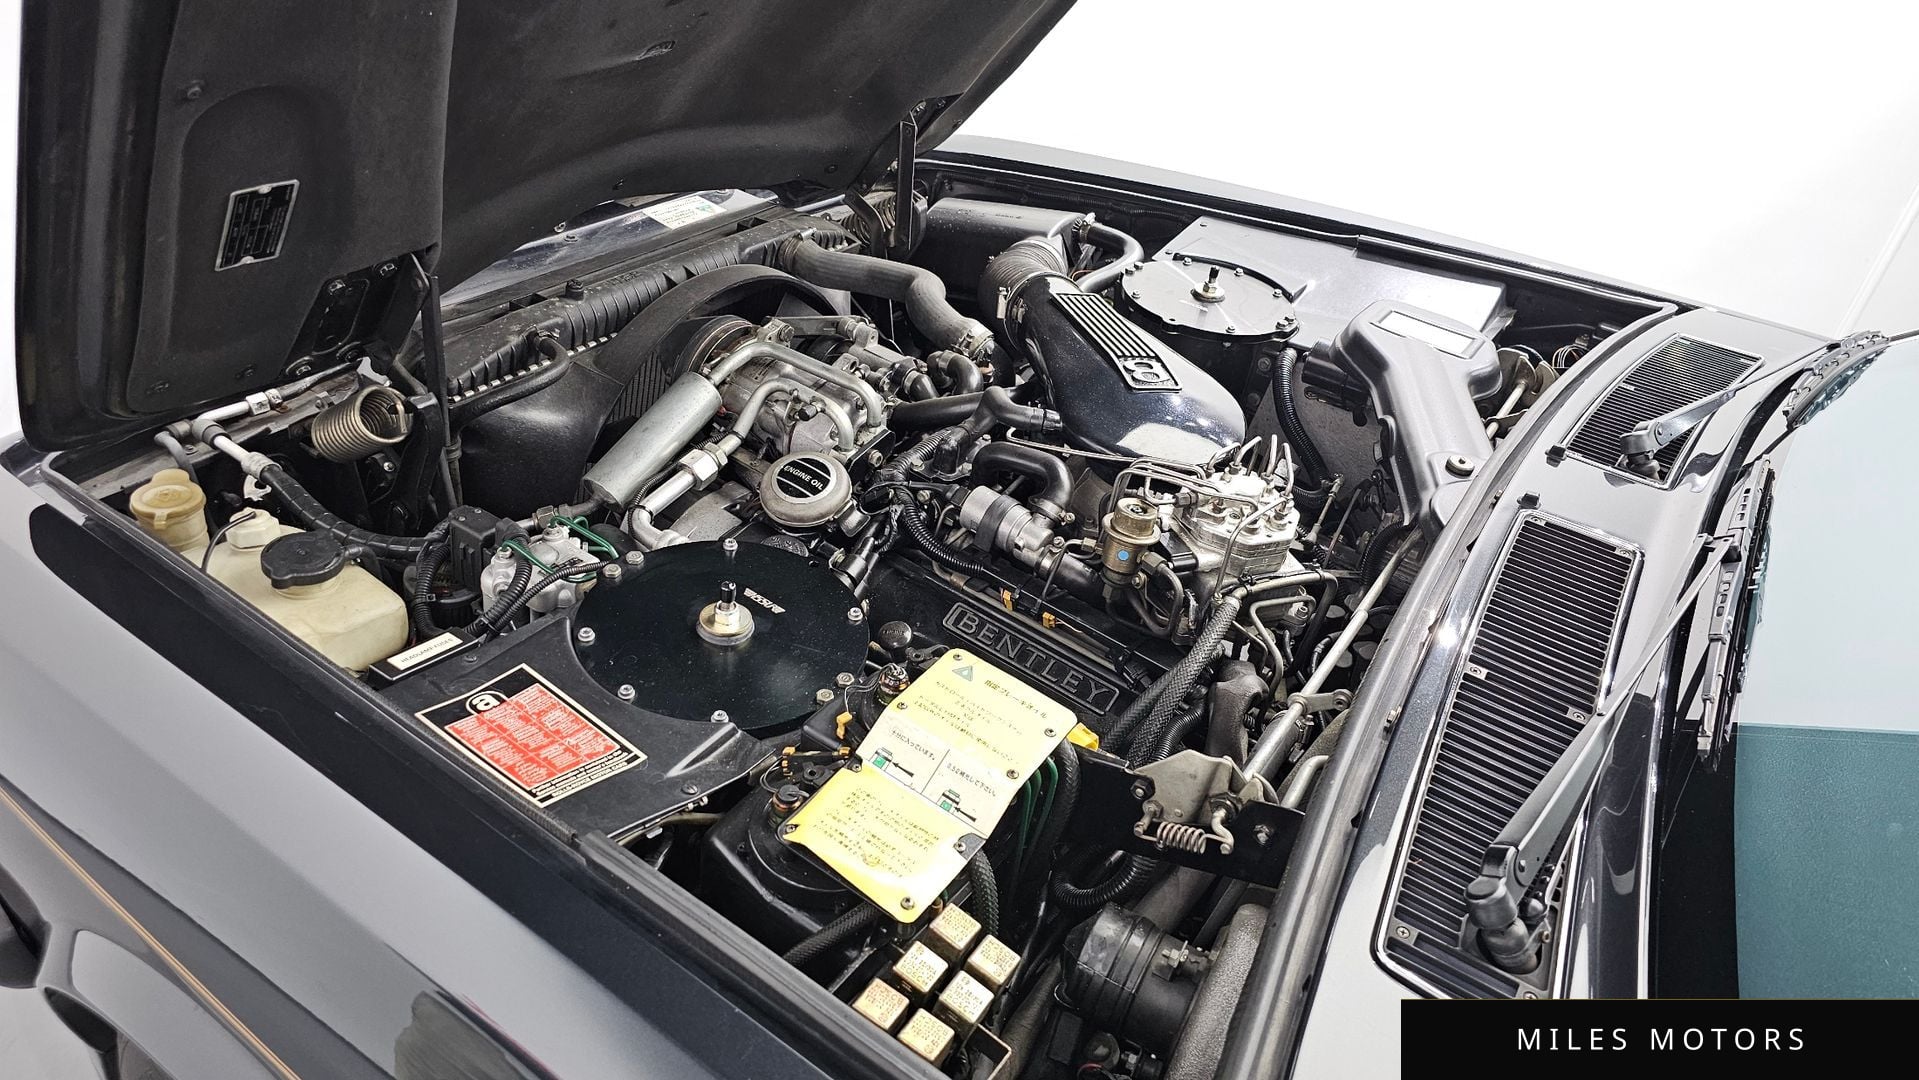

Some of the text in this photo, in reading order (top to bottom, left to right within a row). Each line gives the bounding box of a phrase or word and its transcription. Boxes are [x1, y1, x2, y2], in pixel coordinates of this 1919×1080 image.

[783, 465, 823, 490] ENGINE OIL
[957, 611, 1109, 703] BENTLEY
